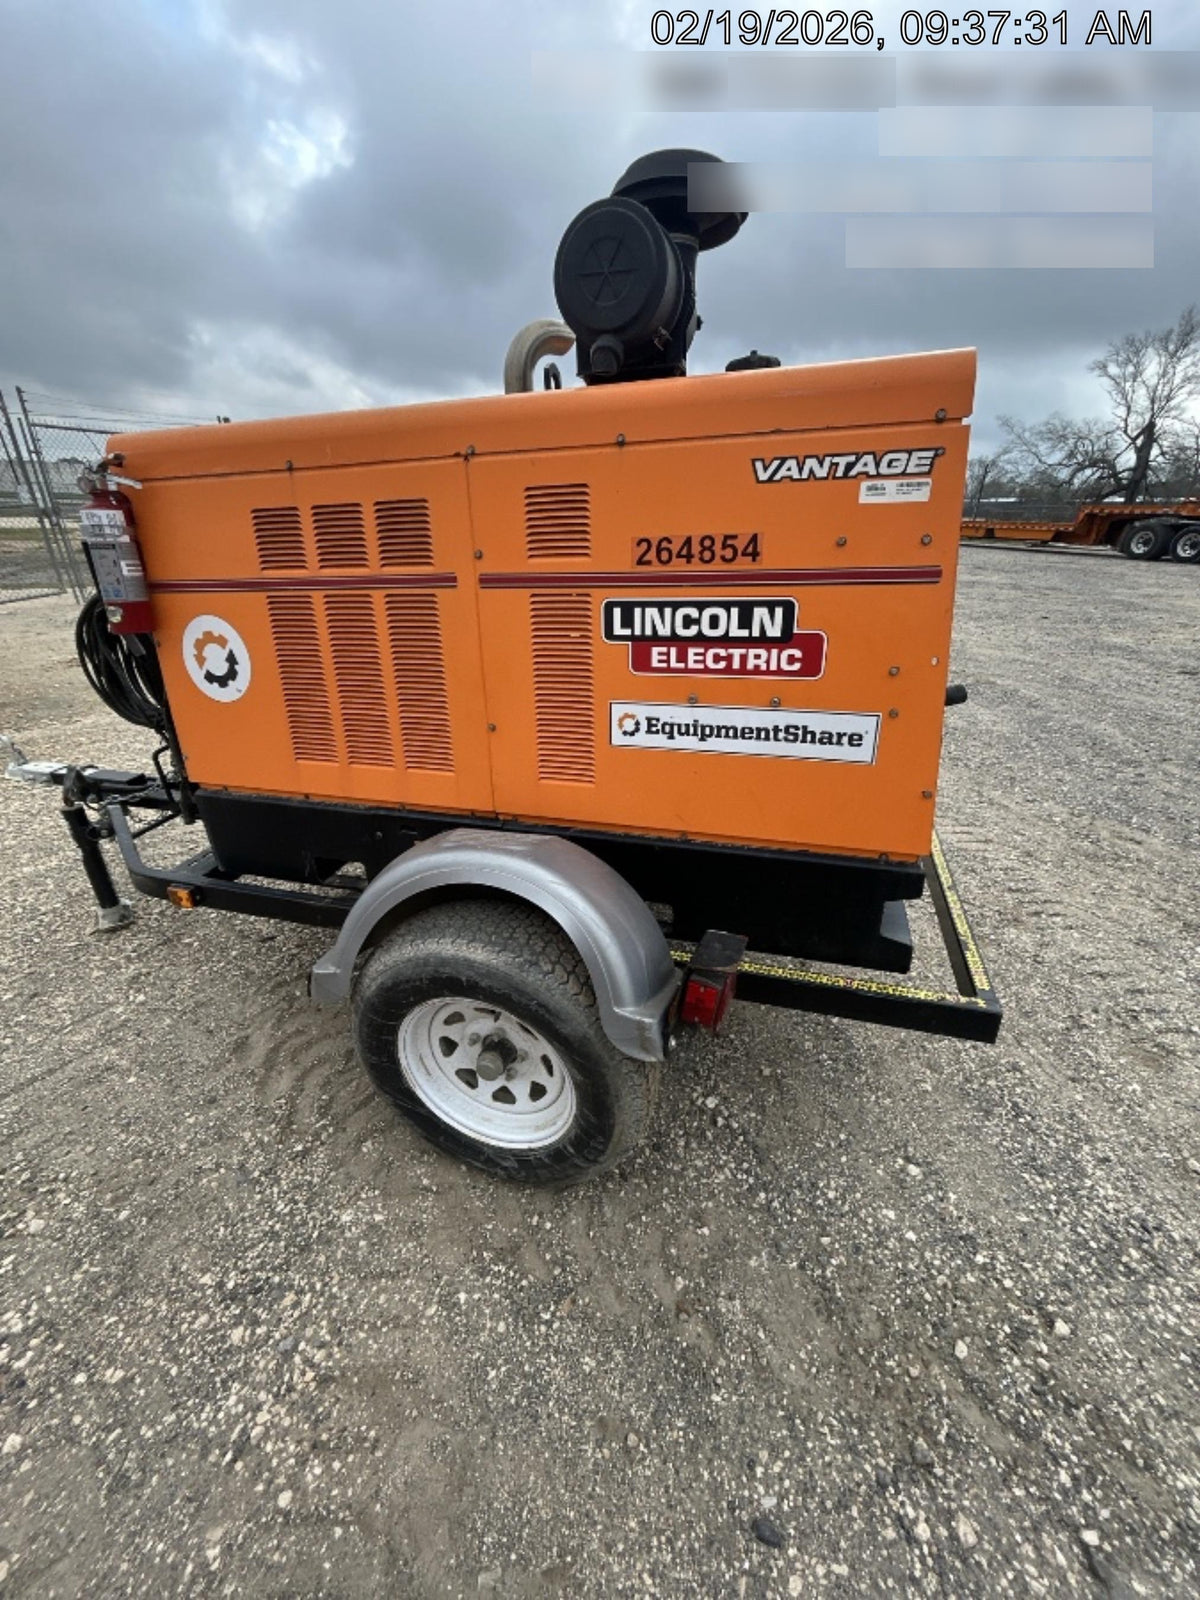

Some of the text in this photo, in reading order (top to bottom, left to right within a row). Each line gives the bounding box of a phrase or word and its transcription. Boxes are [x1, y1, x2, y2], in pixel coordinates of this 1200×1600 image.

[635, 533, 761, 567] 264854
[612, 607, 783, 637] LINCOLN
[651, 646, 802, 672] ELECTRIC
[645, 716, 864, 747] EquipmentShare
